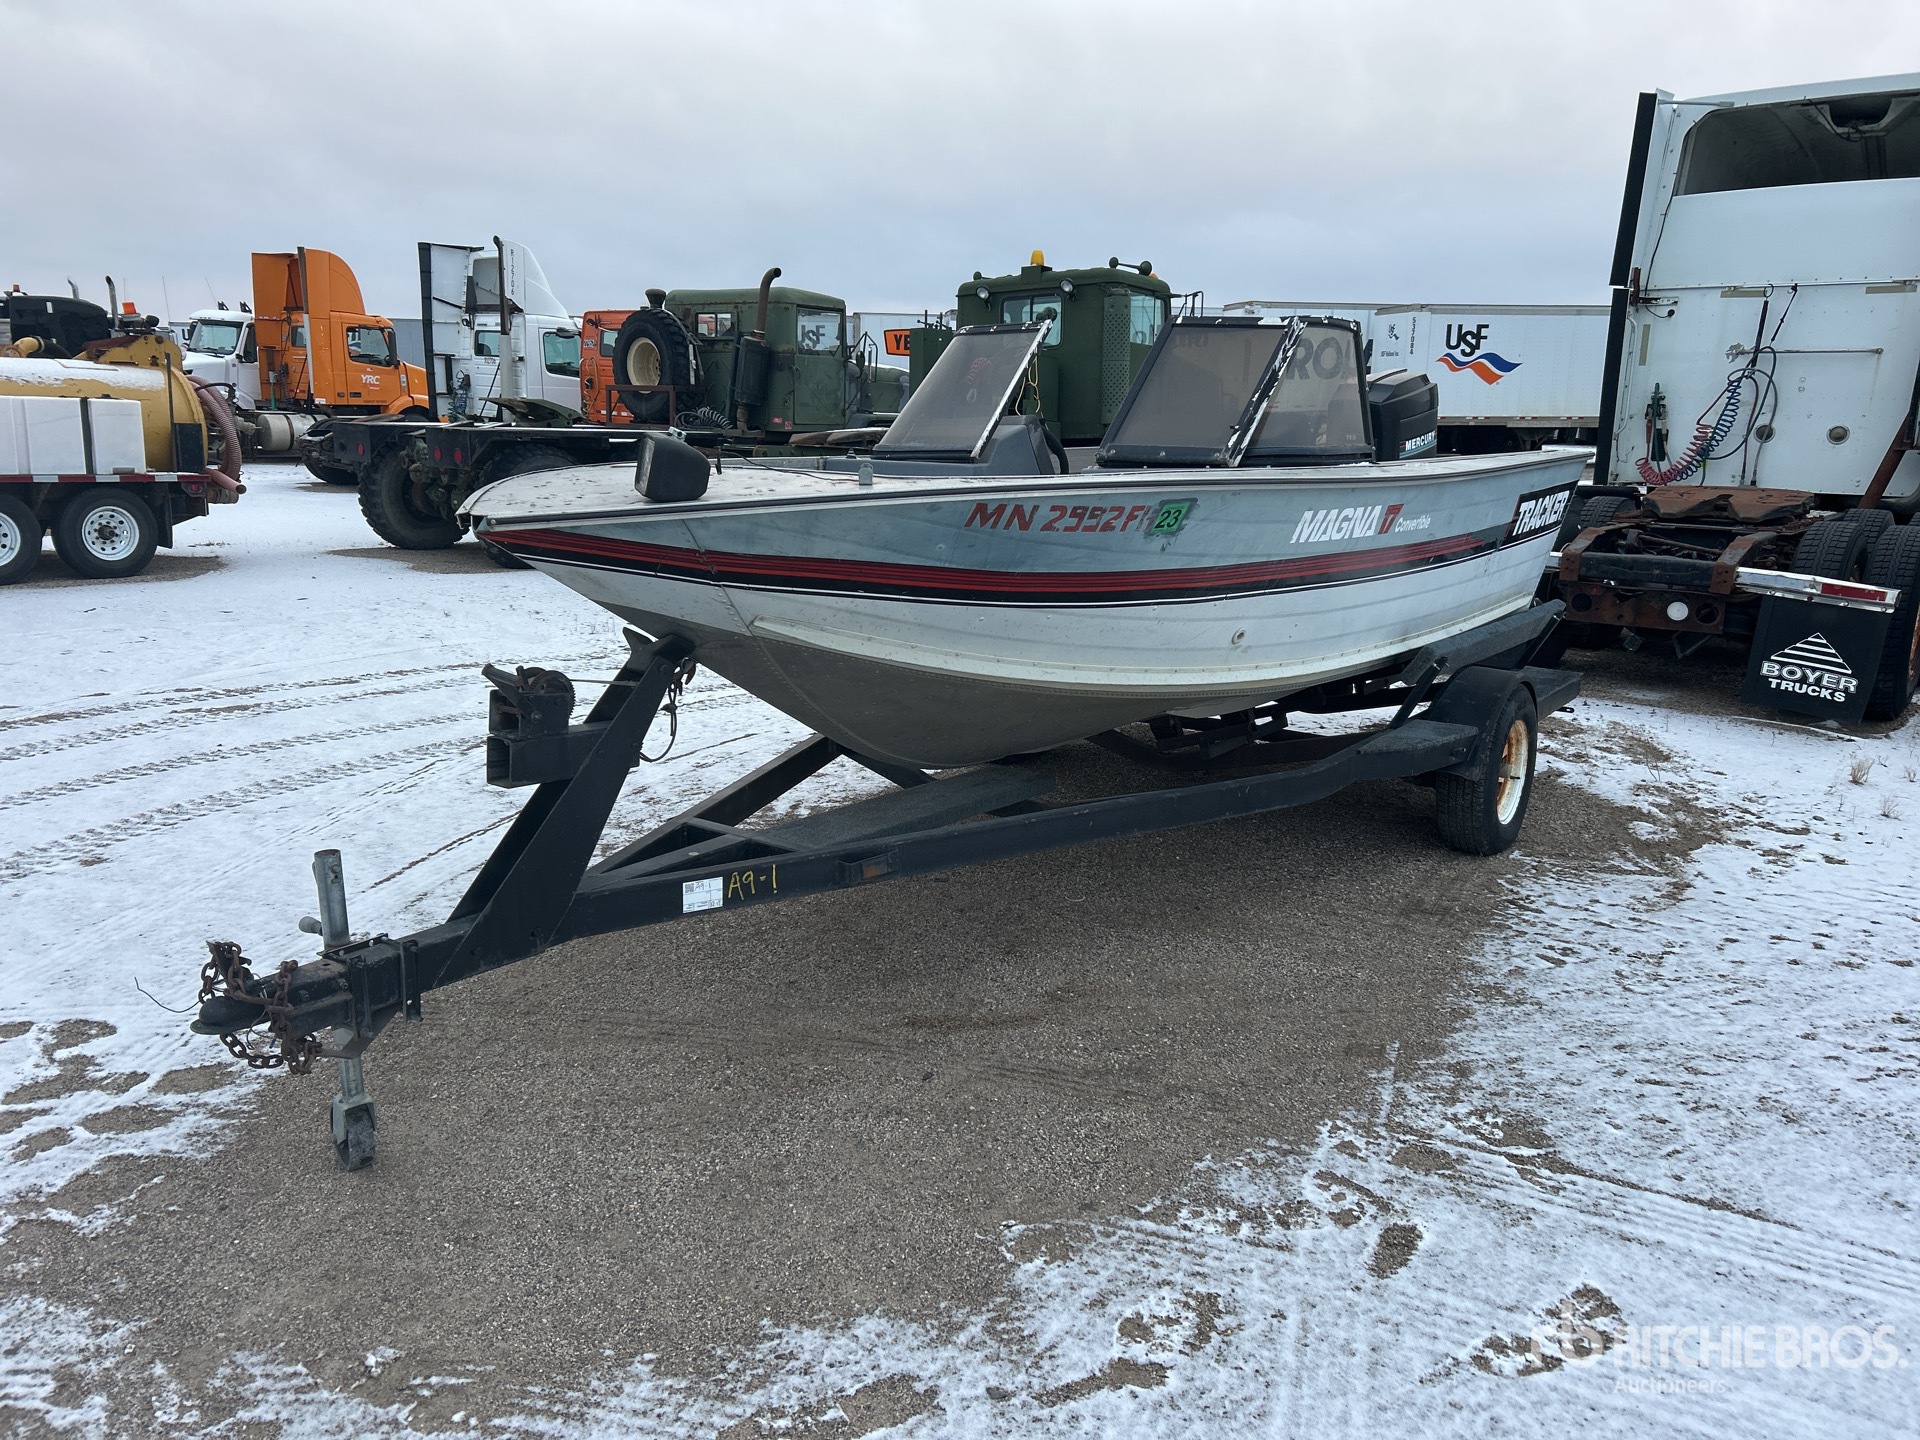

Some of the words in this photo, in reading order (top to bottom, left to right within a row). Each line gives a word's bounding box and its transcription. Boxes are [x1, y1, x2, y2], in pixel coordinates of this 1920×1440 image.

[1445, 324, 1490, 357] USF
[361, 374, 380, 384] YRC
[1405, 430, 1436, 451] MERCURY
[963, 502, 1040, 531] MN
[1154, 509, 1182, 529] 23
[1289, 505, 1383, 544] MAGNA
[1394, 514, 1431, 533] Convertible
[1512, 490, 1570, 537] TRACKER
[1760, 661, 1858, 693] BOYER
[1768, 678, 1846, 702] TRUCKS
